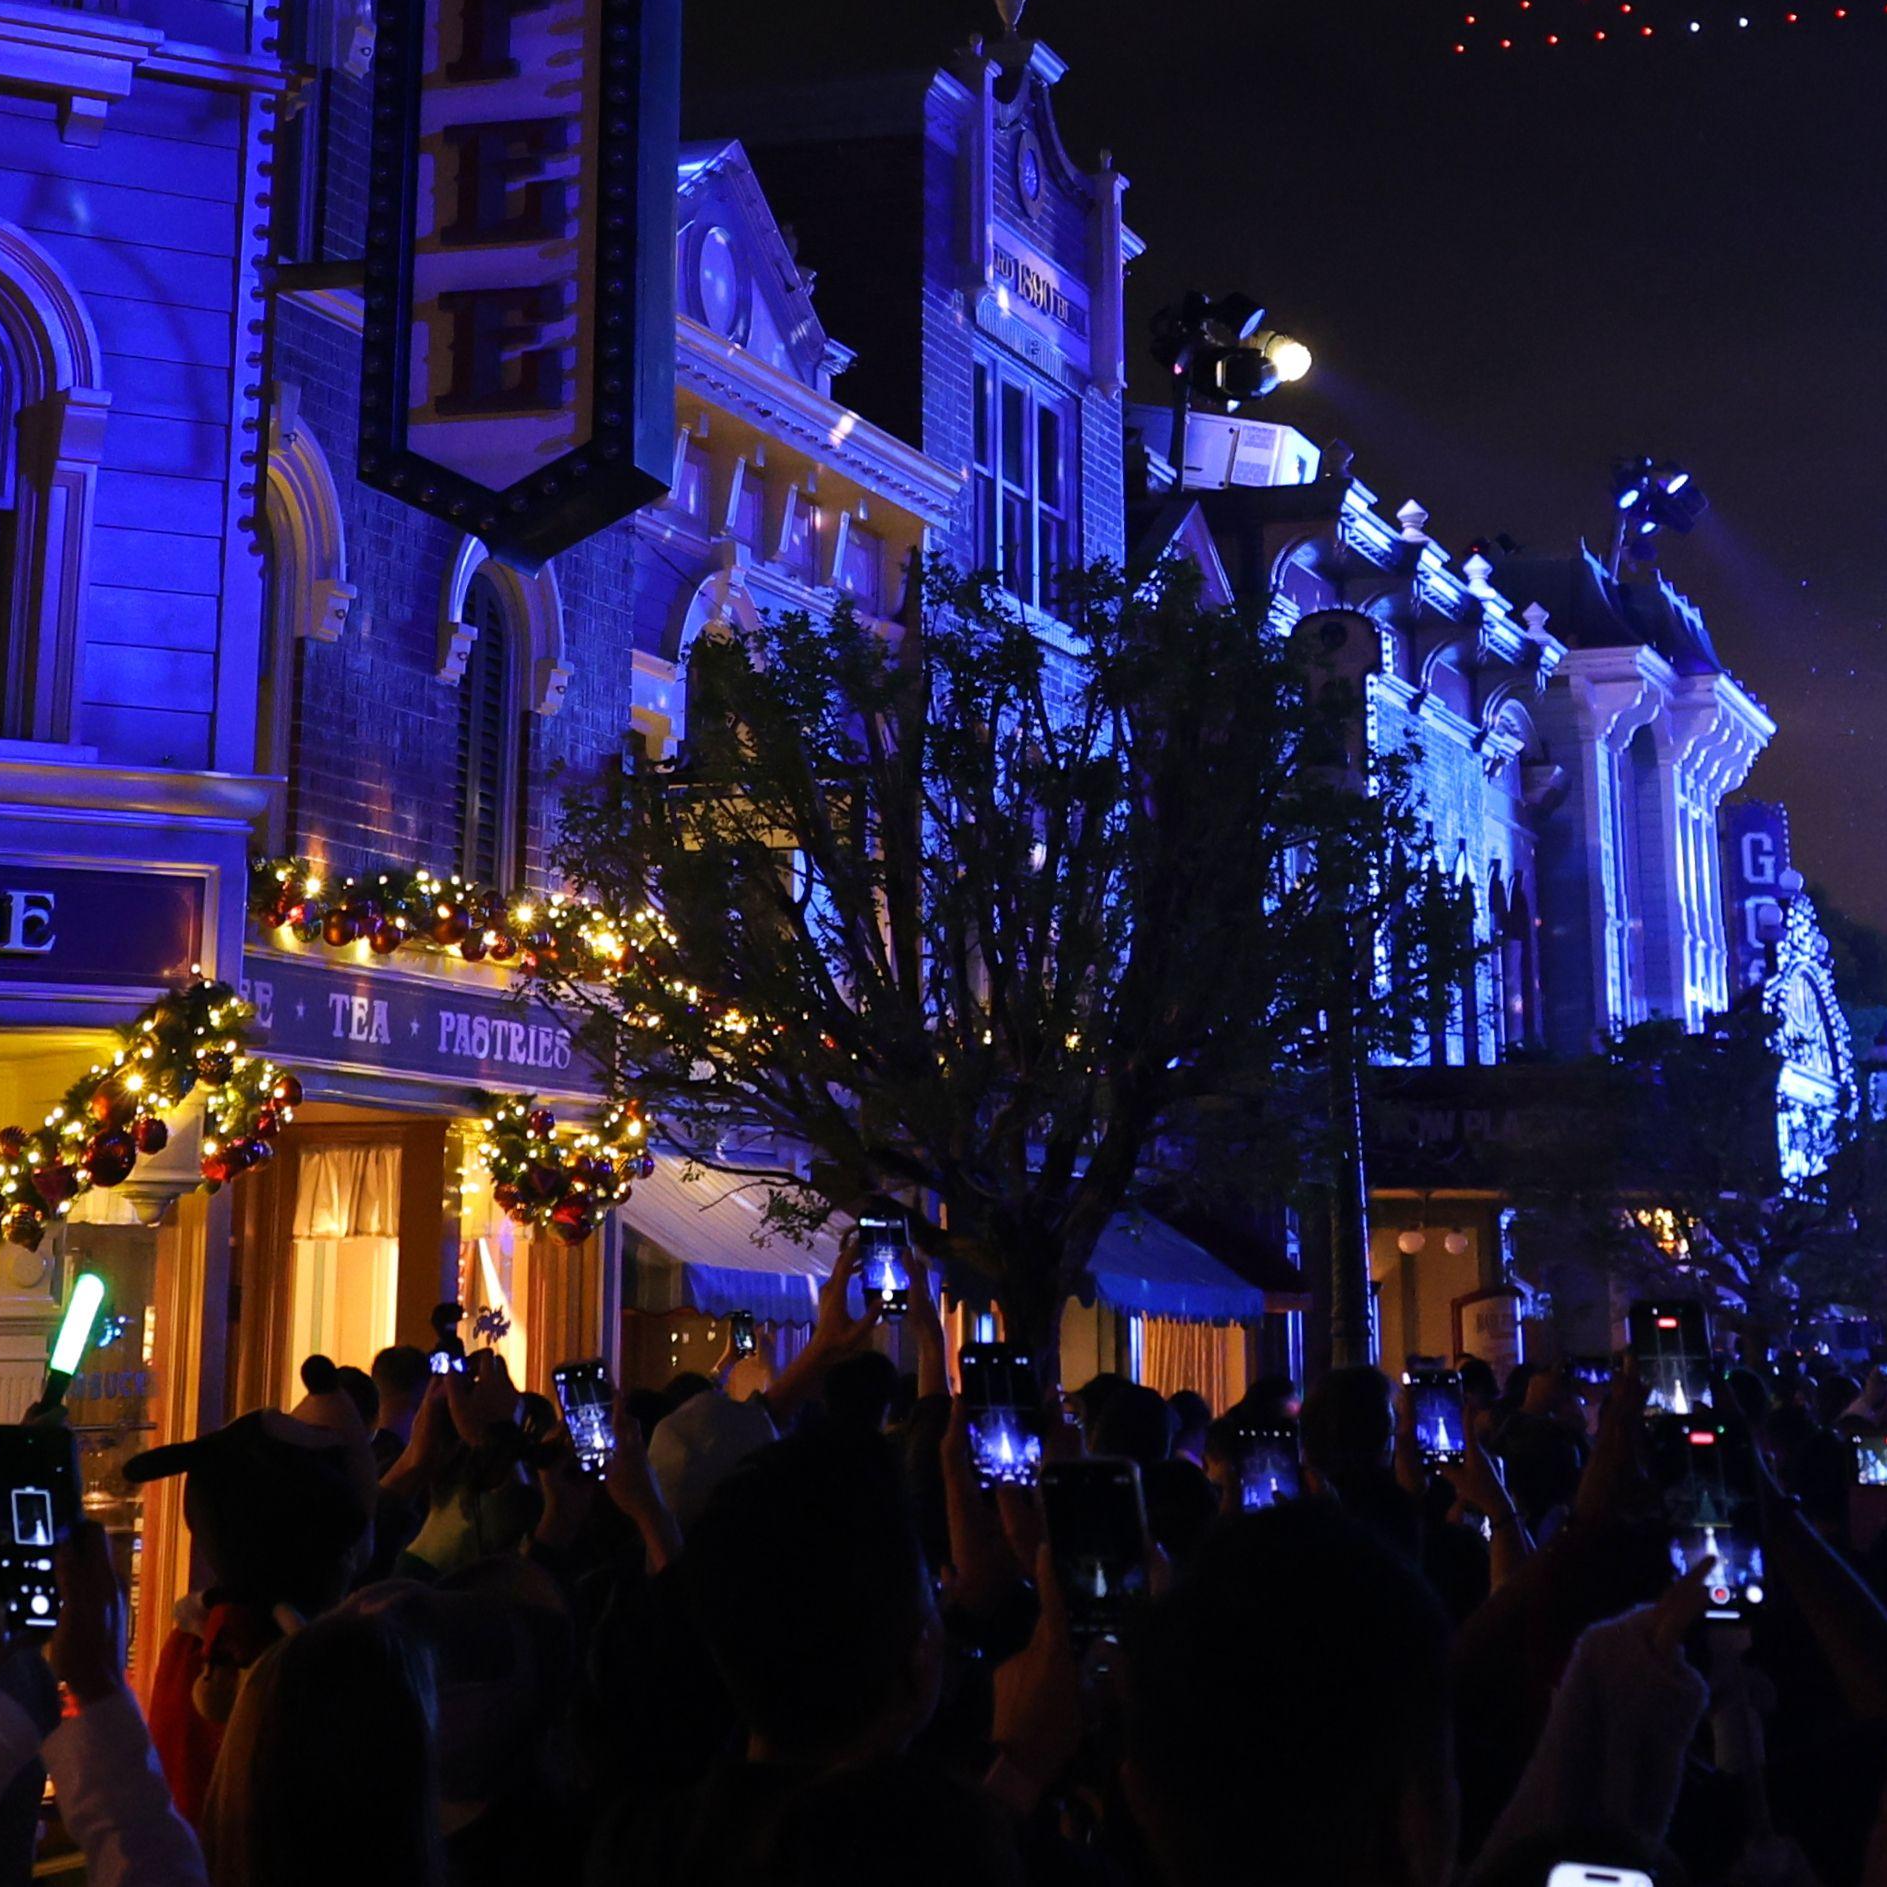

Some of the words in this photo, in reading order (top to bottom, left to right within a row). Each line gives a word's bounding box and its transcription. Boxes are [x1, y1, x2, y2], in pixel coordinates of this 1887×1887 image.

[1016, 258, 1055, 316] 1890
[328, 992, 392, 1045] TEA
[438, 1011, 572, 1069] PASTRIES
